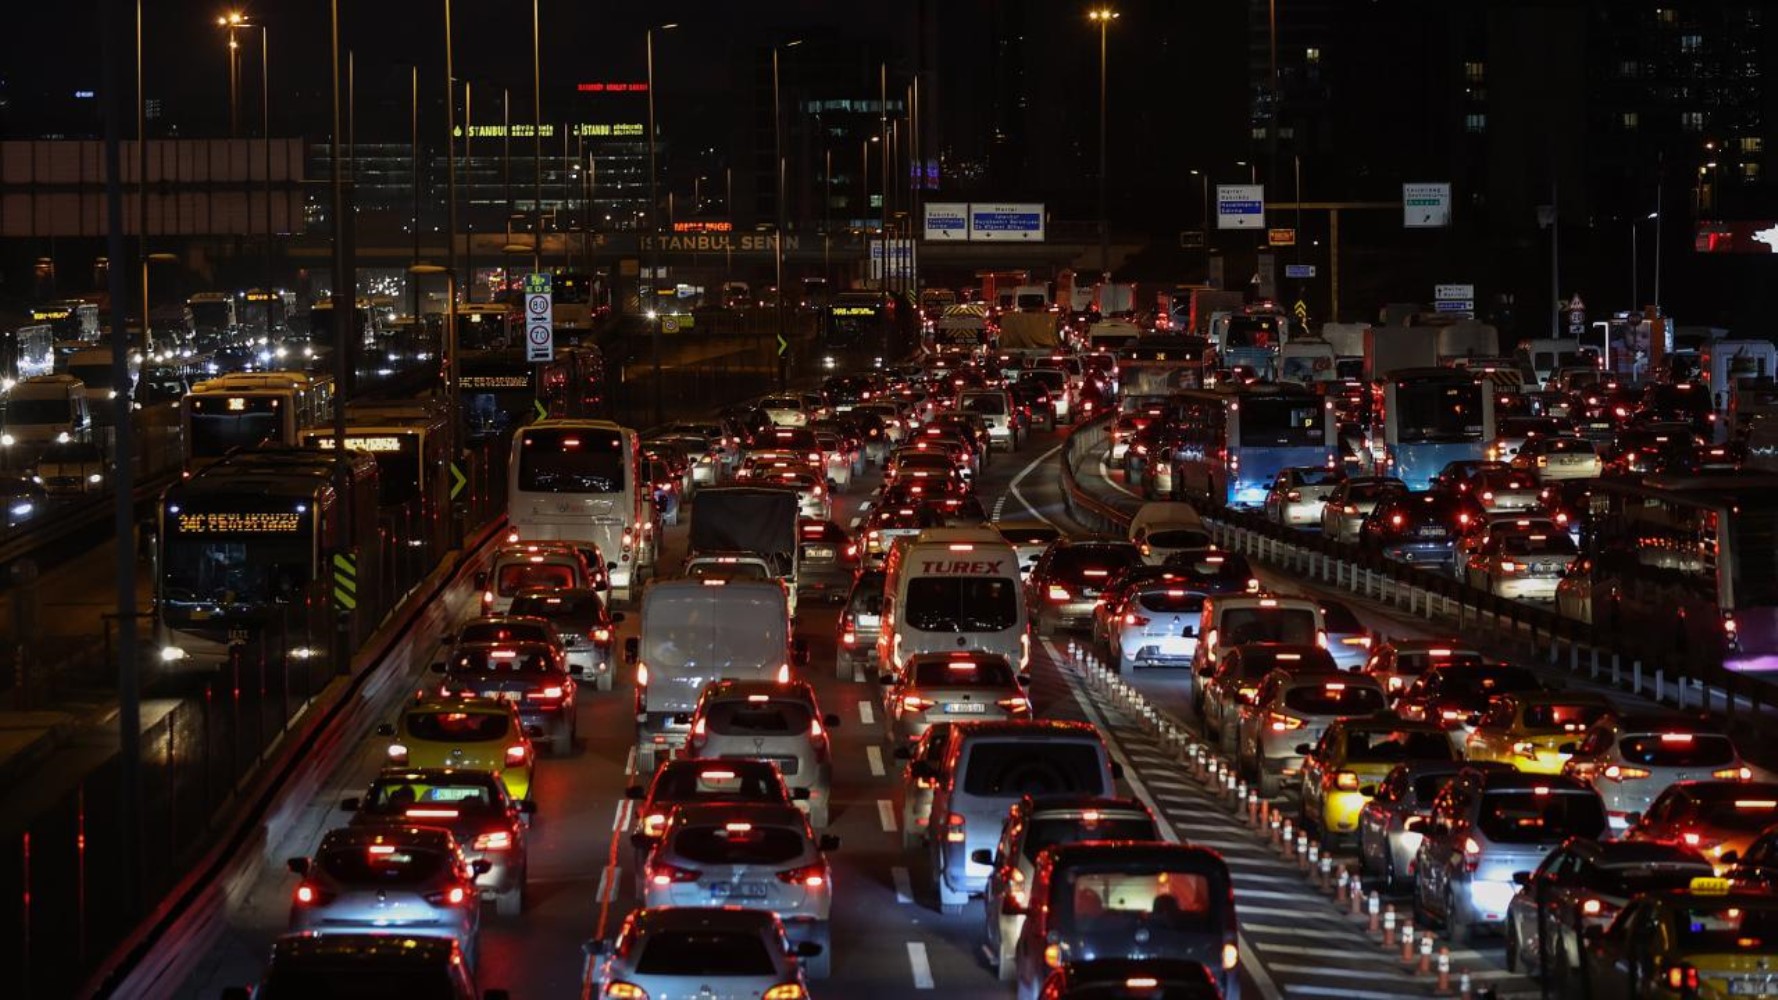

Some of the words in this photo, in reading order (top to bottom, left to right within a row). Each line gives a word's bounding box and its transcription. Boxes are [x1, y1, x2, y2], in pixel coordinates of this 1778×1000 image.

[532, 300, 545, 310] 80
[534, 331, 546, 341] 70
[921, 560, 1003, 574] TUREX
